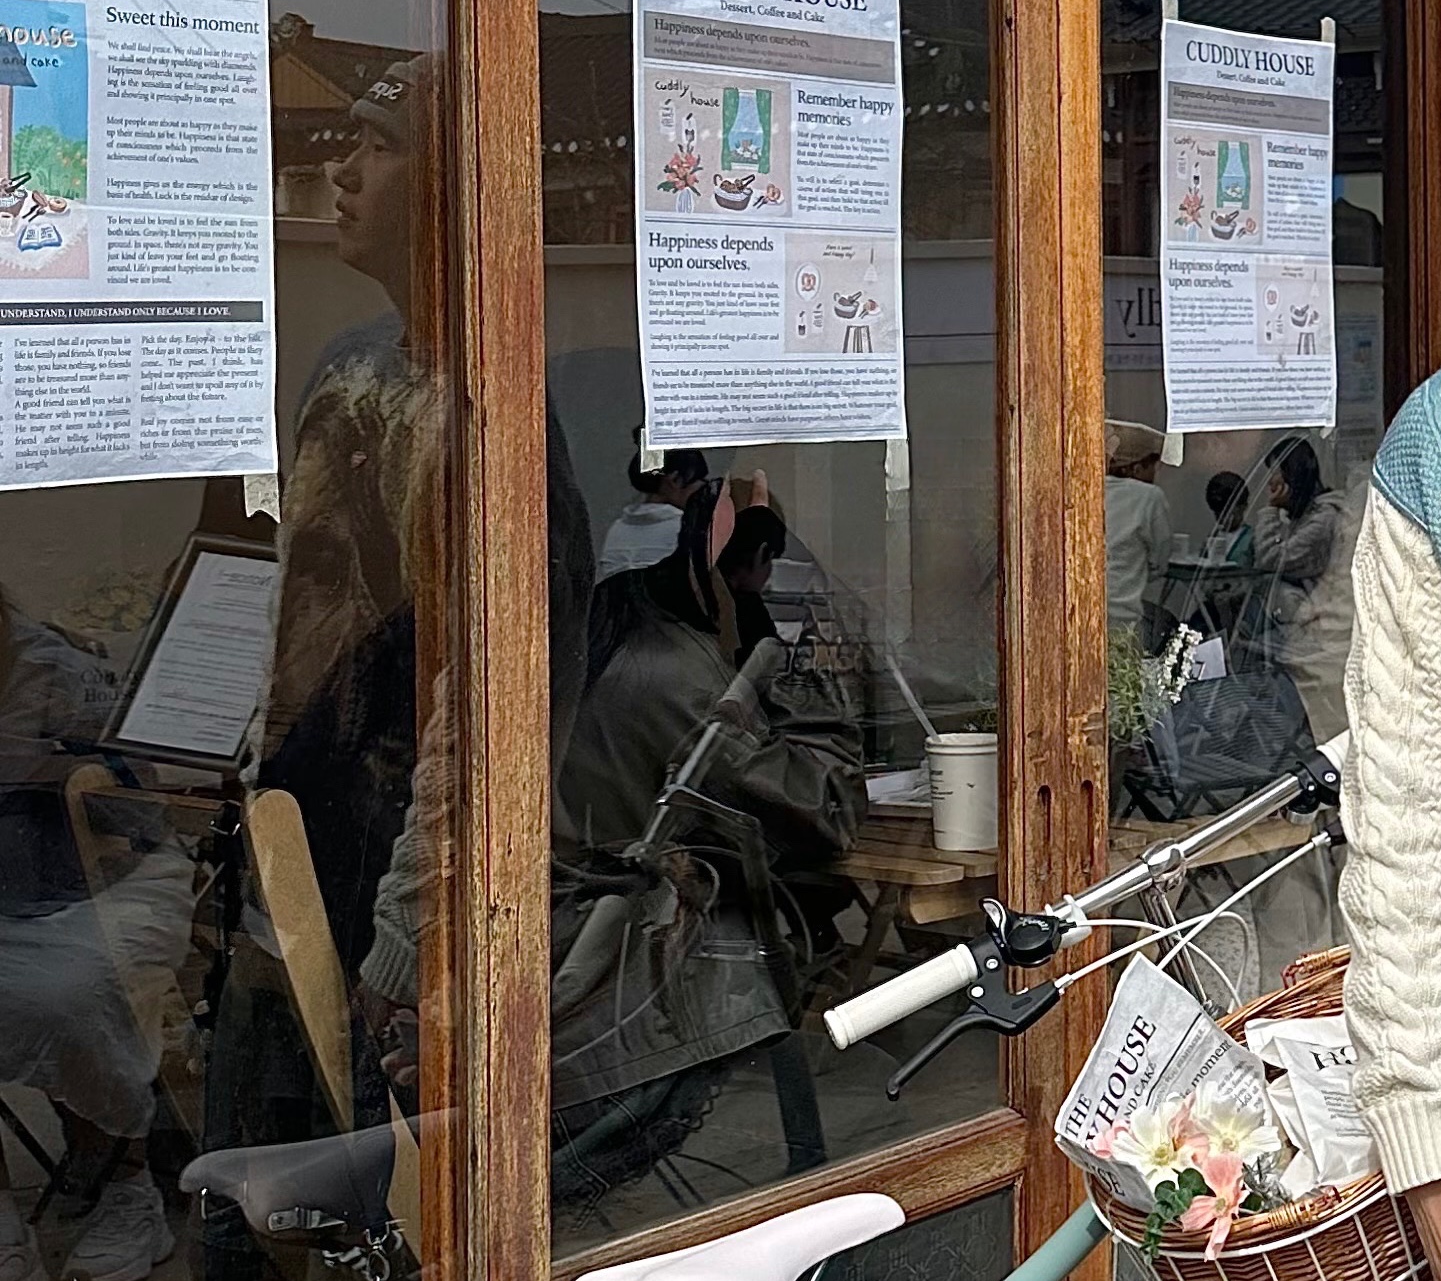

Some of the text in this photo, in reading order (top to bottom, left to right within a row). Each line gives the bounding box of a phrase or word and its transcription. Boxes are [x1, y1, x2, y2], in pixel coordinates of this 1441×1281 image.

[106, 7, 260, 34] Sweet this moment
[720, 0, 825, 23] Dessert, Coffee and Cake
[654, 19, 705, 38] Happiness
[706, 24, 743, 43] depends
[745, 33, 768, 47] upon
[2, 53, 27, 67] and
[1186, 40, 1316, 77] CUDDLY HOUSE
[690, 91, 720, 107] house
[798, 90, 894, 115] Remember happy
[798, 111, 852, 127] memories
[648, 233, 774, 257] Happiness depends
[648, 253, 750, 273] upon ourselves.
[1168, 259, 1249, 276] Happiness depends
[1168, 279, 1192, 291] upon
[73, 308, 132, 318] UNDERSTAND
[133, 307, 156, 317] ONLY
[157, 307, 196, 316] BECAUSE
[1096, 1015, 1157, 1127] HOUSE
[1065, 1093, 1092, 1138] THE
